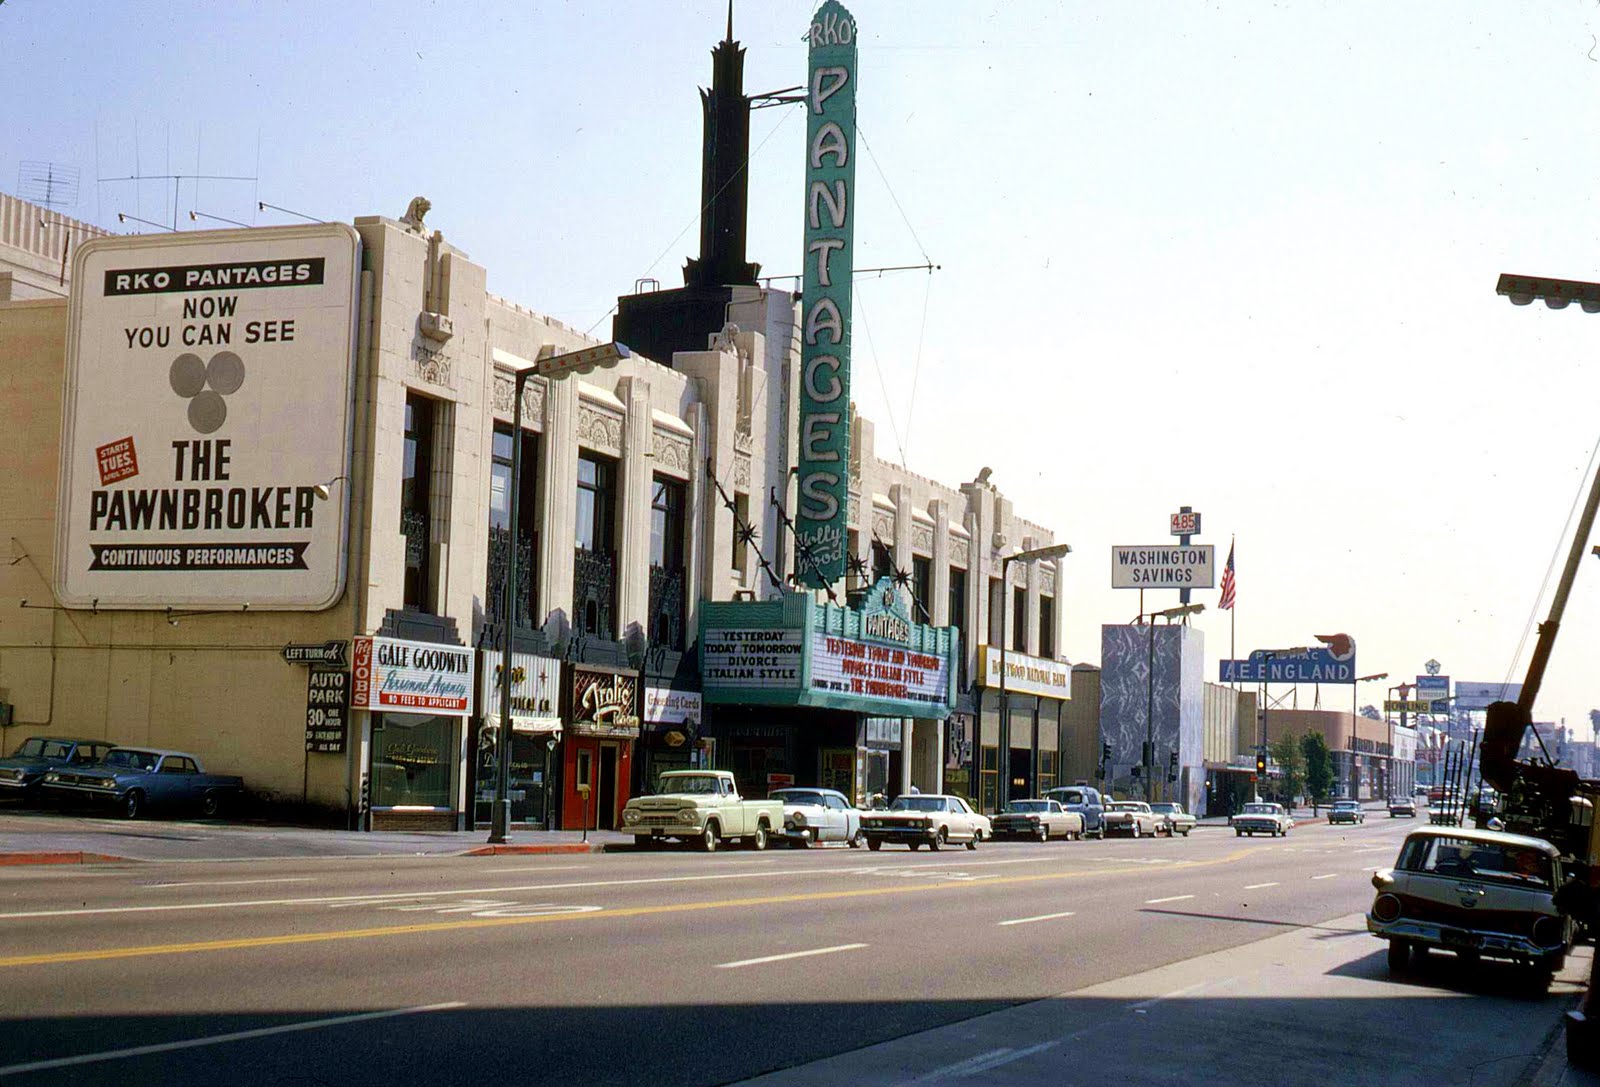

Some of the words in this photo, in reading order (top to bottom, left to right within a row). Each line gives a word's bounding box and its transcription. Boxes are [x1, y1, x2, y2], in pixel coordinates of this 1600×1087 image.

[811, 12, 851, 48] RKO
[116, 272, 171, 291] RKO
[186, 264, 311, 286] PANTAGES
[801, 66, 849, 521] PANTAGES
[183, 296, 238, 319] NOW
[125, 326, 170, 349] YOU
[182, 323, 231, 346] CAN
[245, 320, 295, 343] SEE
[101, 441, 129, 459] STARTS
[172, 439, 231, 481] THE
[90, 486, 314, 531] PAWNBROKER
[101, 548, 181, 566] CONTINUOUS
[186, 548, 294, 565] PERFORMANCES
[1119, 551, 1206, 565] WASHINGTON
[1132, 568, 1193, 582] SAVINGS
[723, 632, 784, 642] YESTERDAY
[865, 614, 910, 643] PANTAGES
[286, 648, 303, 659] LEFT
[304, 648, 324, 659] TURN
[705, 643, 736, 654] TODAY
[743, 643, 802, 654] TOMORROW
[378, 643, 409, 667] GALE
[413, 648, 470, 673] GOODWIN
[729, 656, 778, 666] DIVORCE
[309, 672, 344, 687] AUTO
[354, 655, 369, 705] JOBS
[709, 669, 753, 678] ITALIAN
[760, 669, 795, 678] STYLE
[1258, 663, 1349, 680] ENGLAND
[431, 675, 467, 698] Agency
[309, 689, 344, 703] PARK
[389, 695, 397, 704] NO
[400, 695, 415, 706] FEES
[418, 697, 425, 706] TO
[428, 697, 460, 708] APPLICANT
[680, 696, 700, 709] Cards
